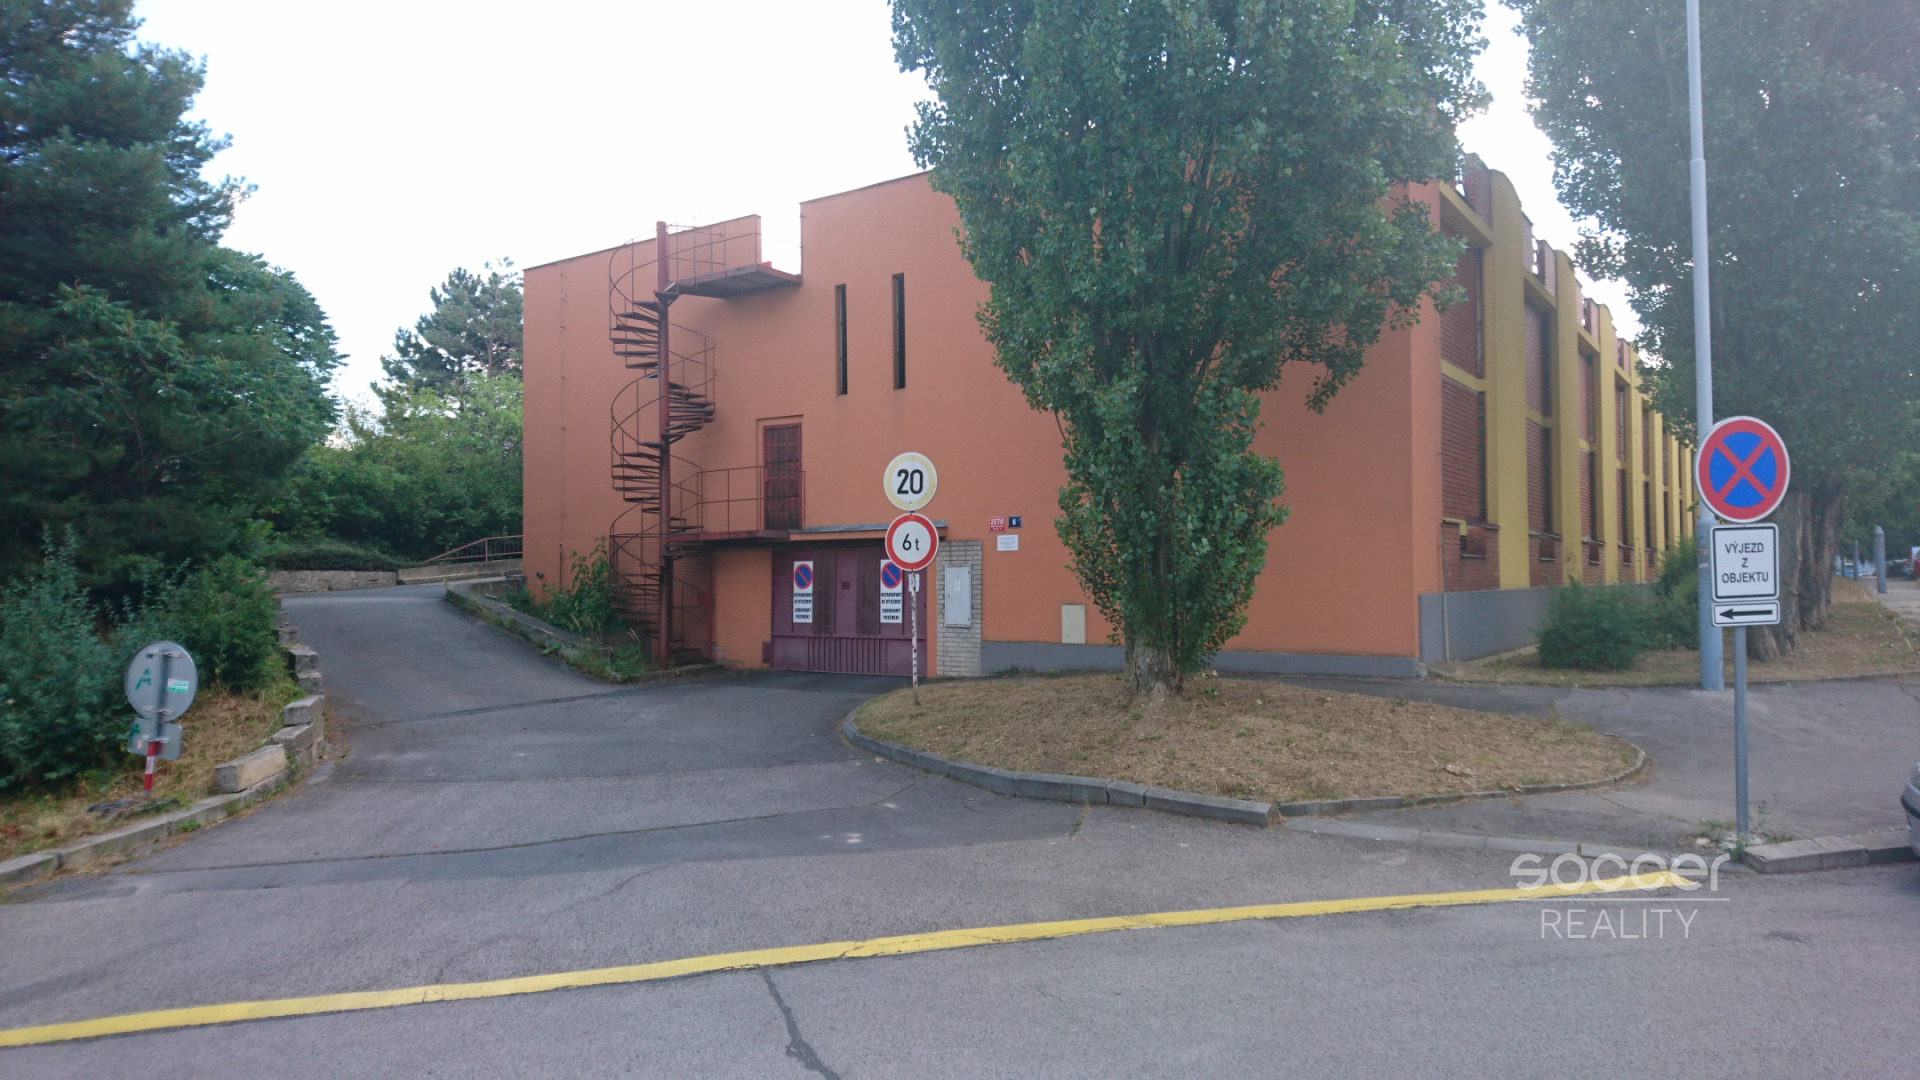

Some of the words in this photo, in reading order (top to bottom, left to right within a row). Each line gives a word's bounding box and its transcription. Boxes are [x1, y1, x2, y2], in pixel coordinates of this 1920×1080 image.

[897, 469, 924, 495] 20
[1725, 541, 1765, 554] VÝJEZD
[1741, 558, 1749, 568] Z
[1722, 571, 1769, 584] OBJEKTU
